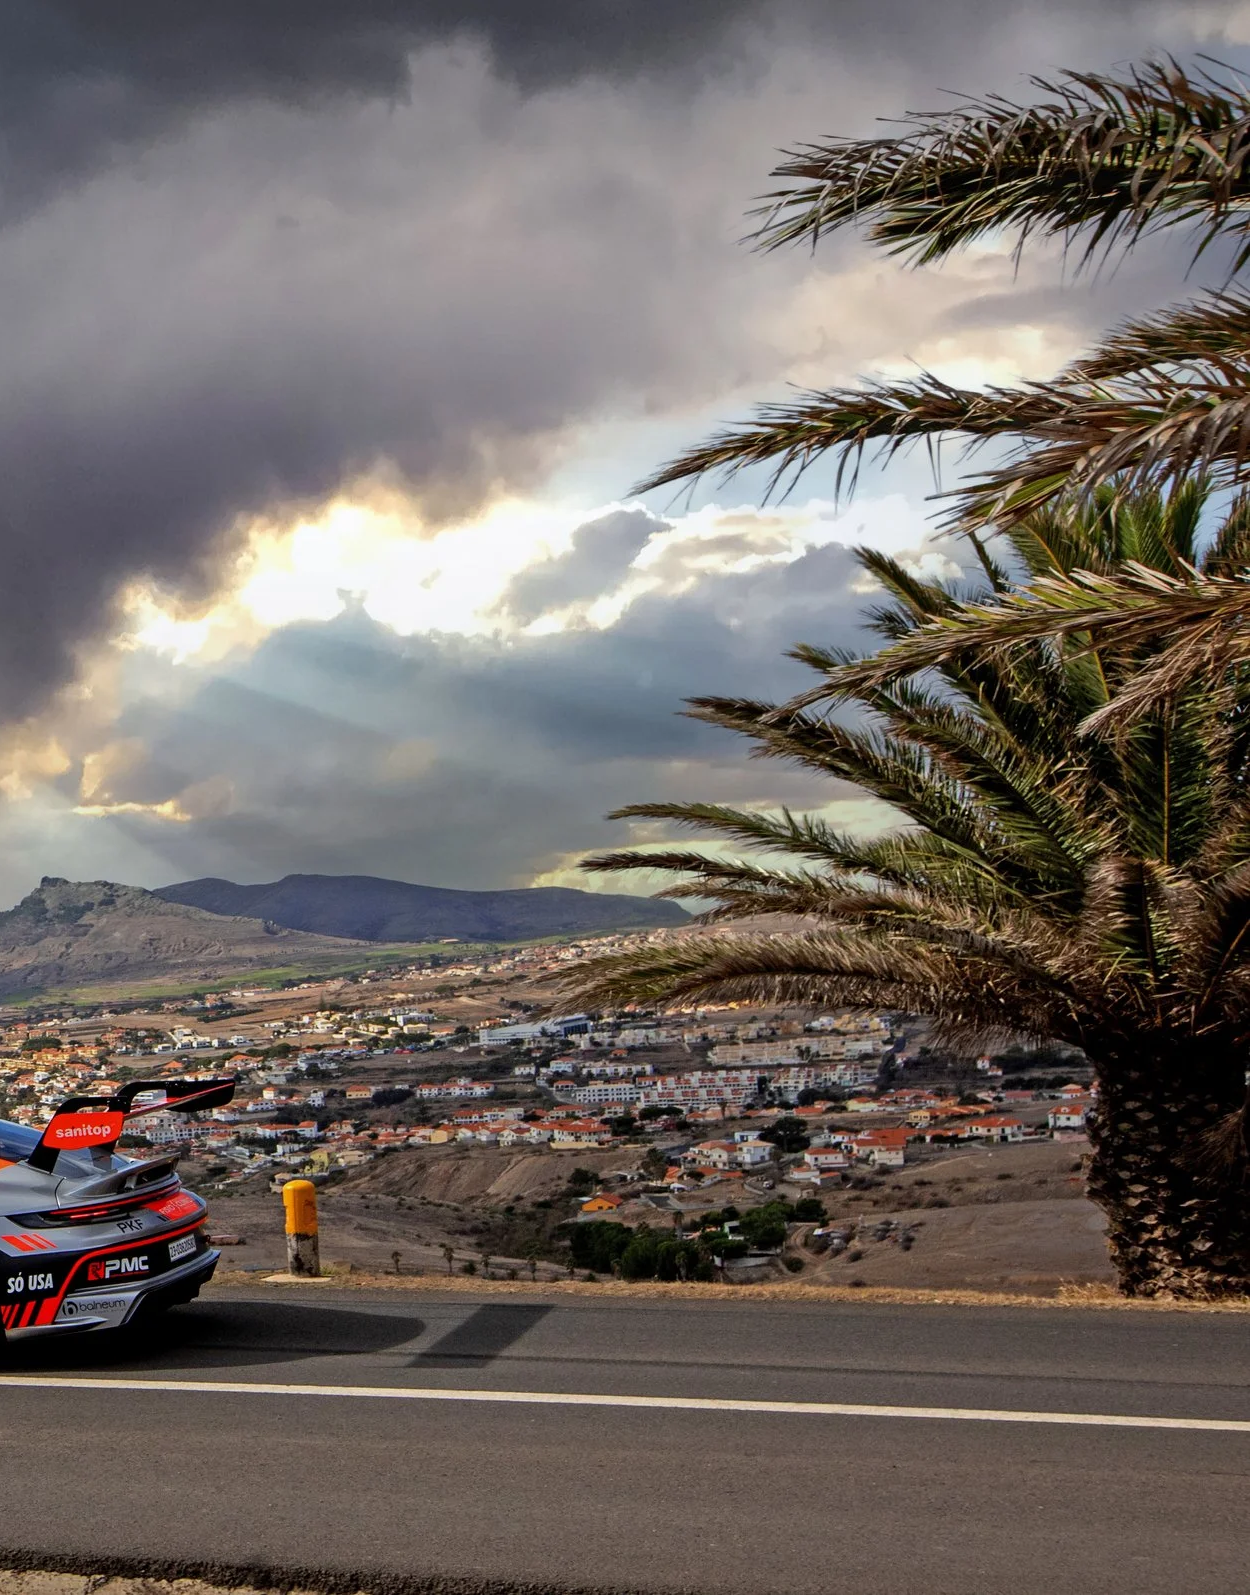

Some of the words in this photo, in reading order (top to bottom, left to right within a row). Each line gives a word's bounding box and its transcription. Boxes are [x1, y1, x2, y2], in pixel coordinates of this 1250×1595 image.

[55, 1122, 112, 1138] sanitop
[116, 1218, 144, 1234] PKF
[105, 1255, 150, 1279] PMC
[7, 1272, 25, 1294] SÓ
[28, 1273, 54, 1291] USA
[79, 1299, 126, 1312] balneum
